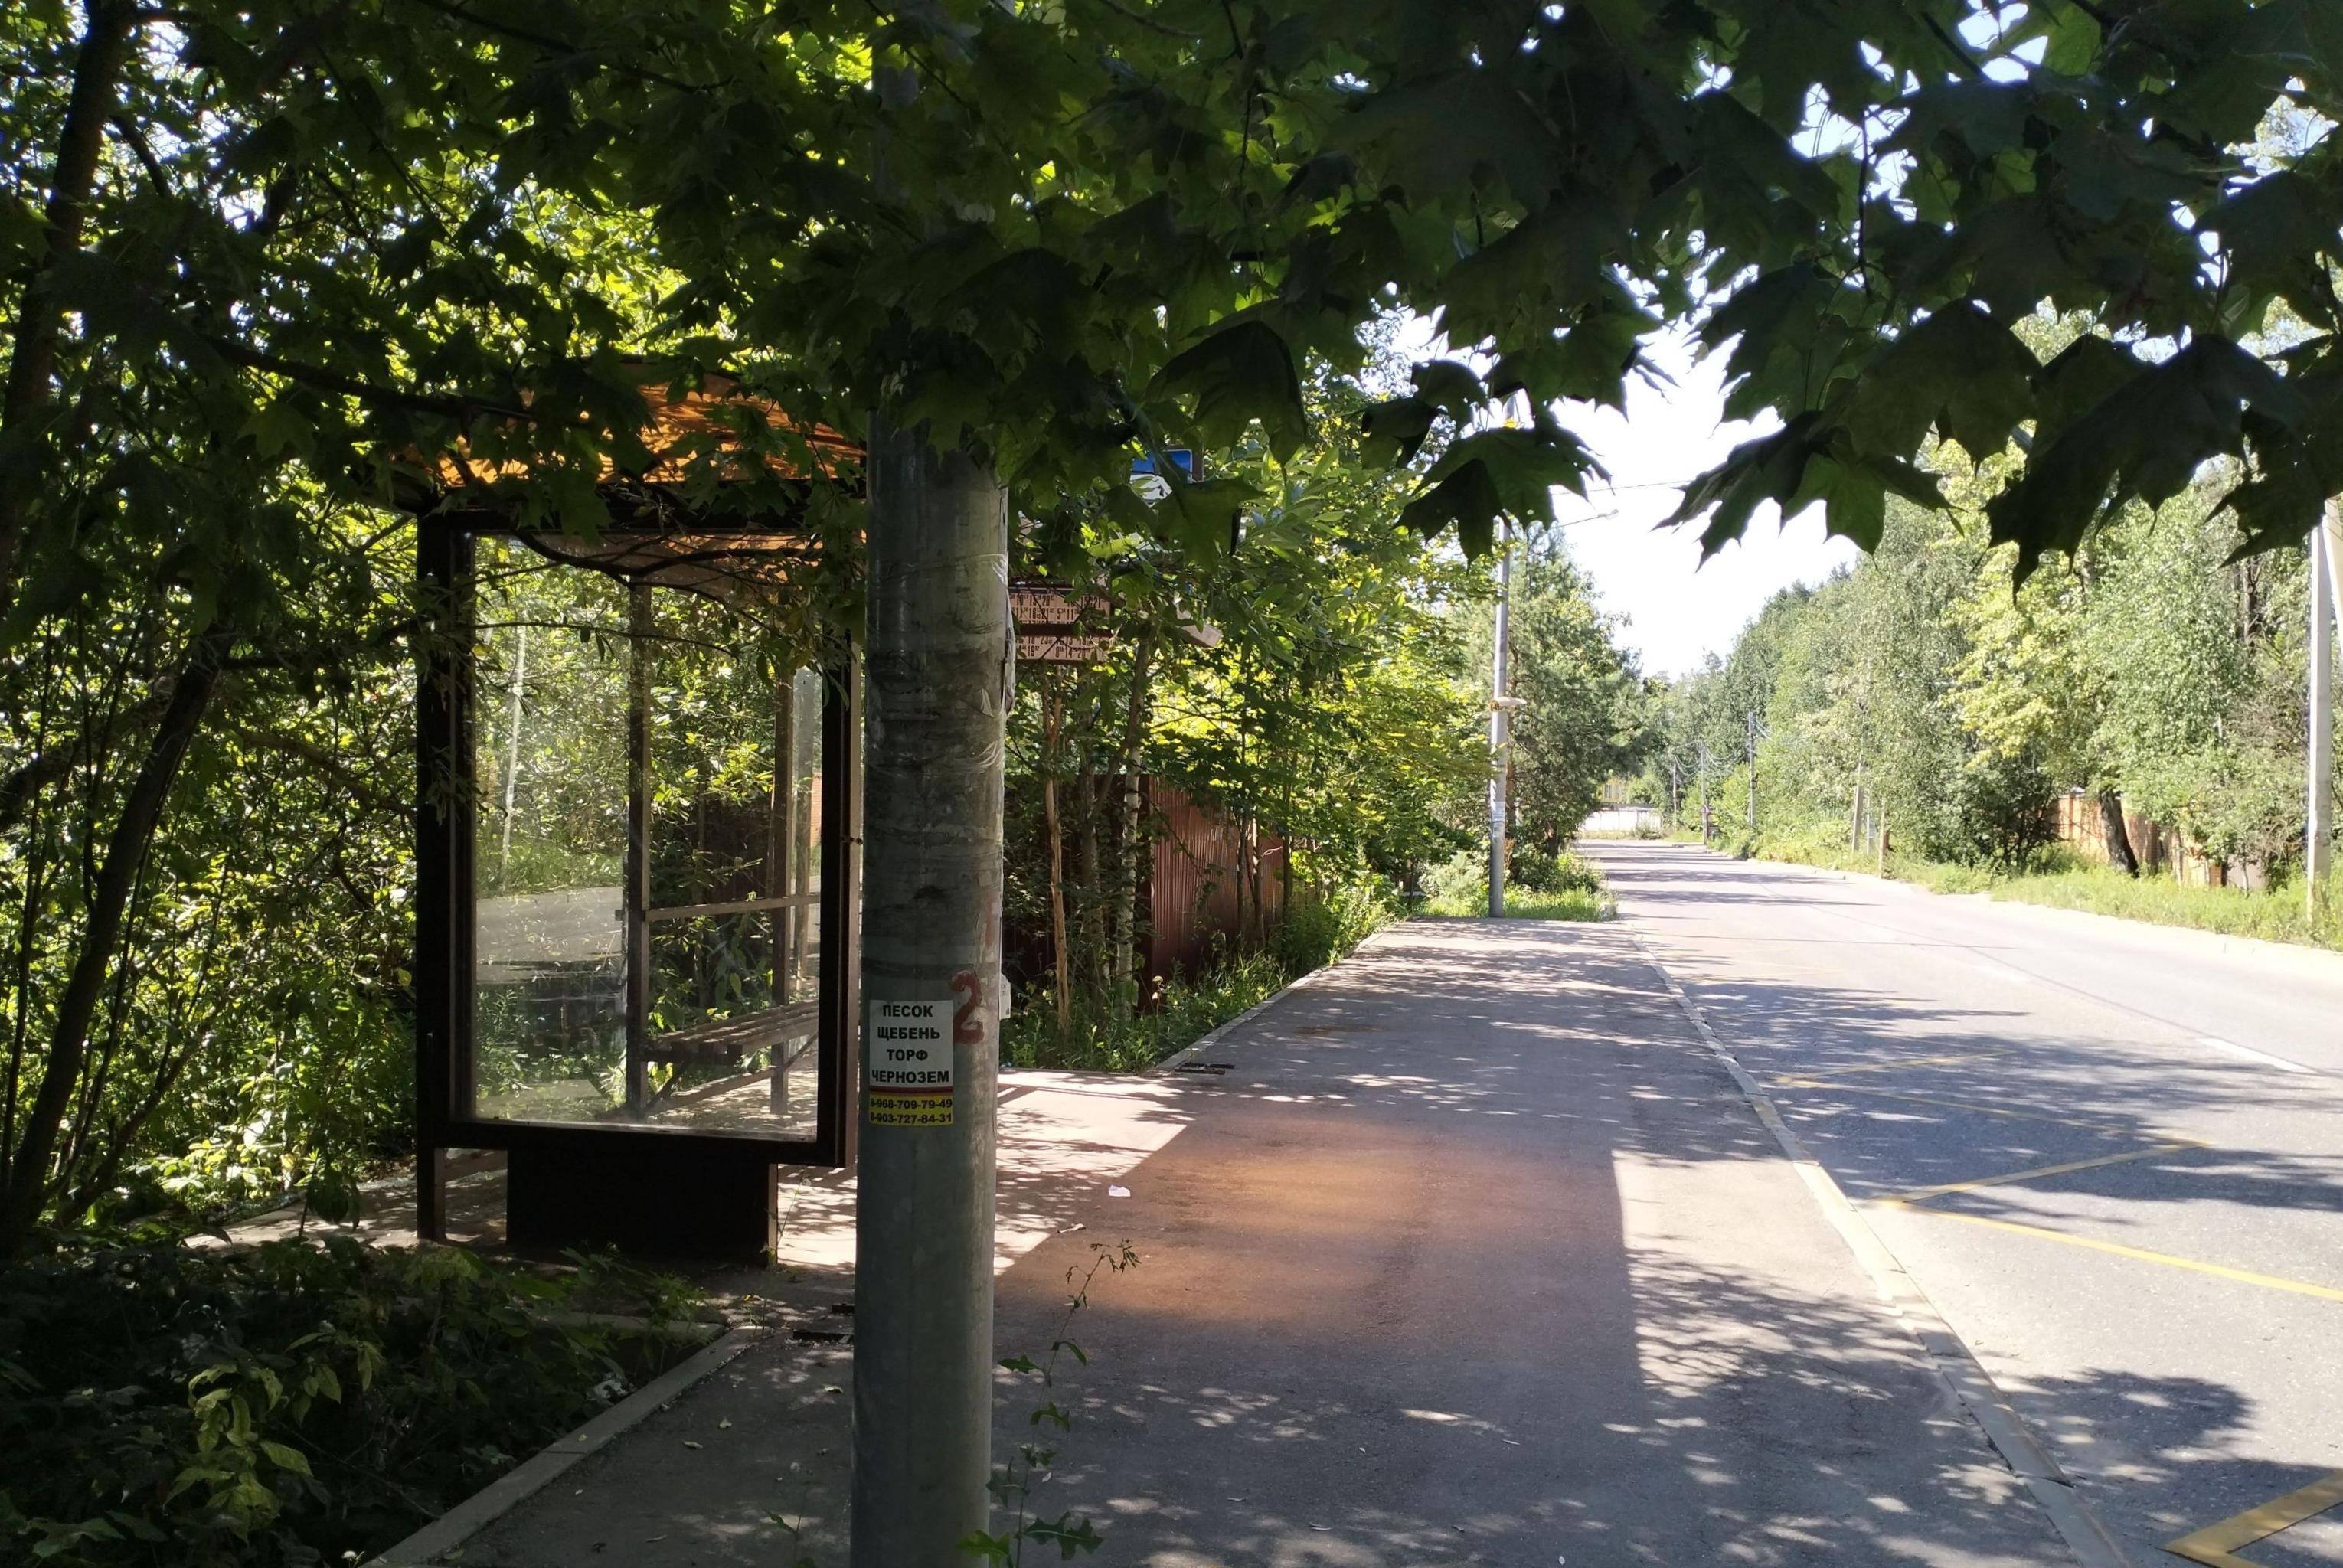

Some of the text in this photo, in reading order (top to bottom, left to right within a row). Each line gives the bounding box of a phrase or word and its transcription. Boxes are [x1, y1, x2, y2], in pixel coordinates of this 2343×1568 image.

[882, 1004, 933, 1018] ПЕСОК
[951, 969, 985, 1044] 2
[877, 1027, 940, 1041] ЩЕБЕНЬ
[887, 1049, 928, 1061] ТОРФ
[871, 1070, 949, 1083] ЧЕРНОЗЕМ
